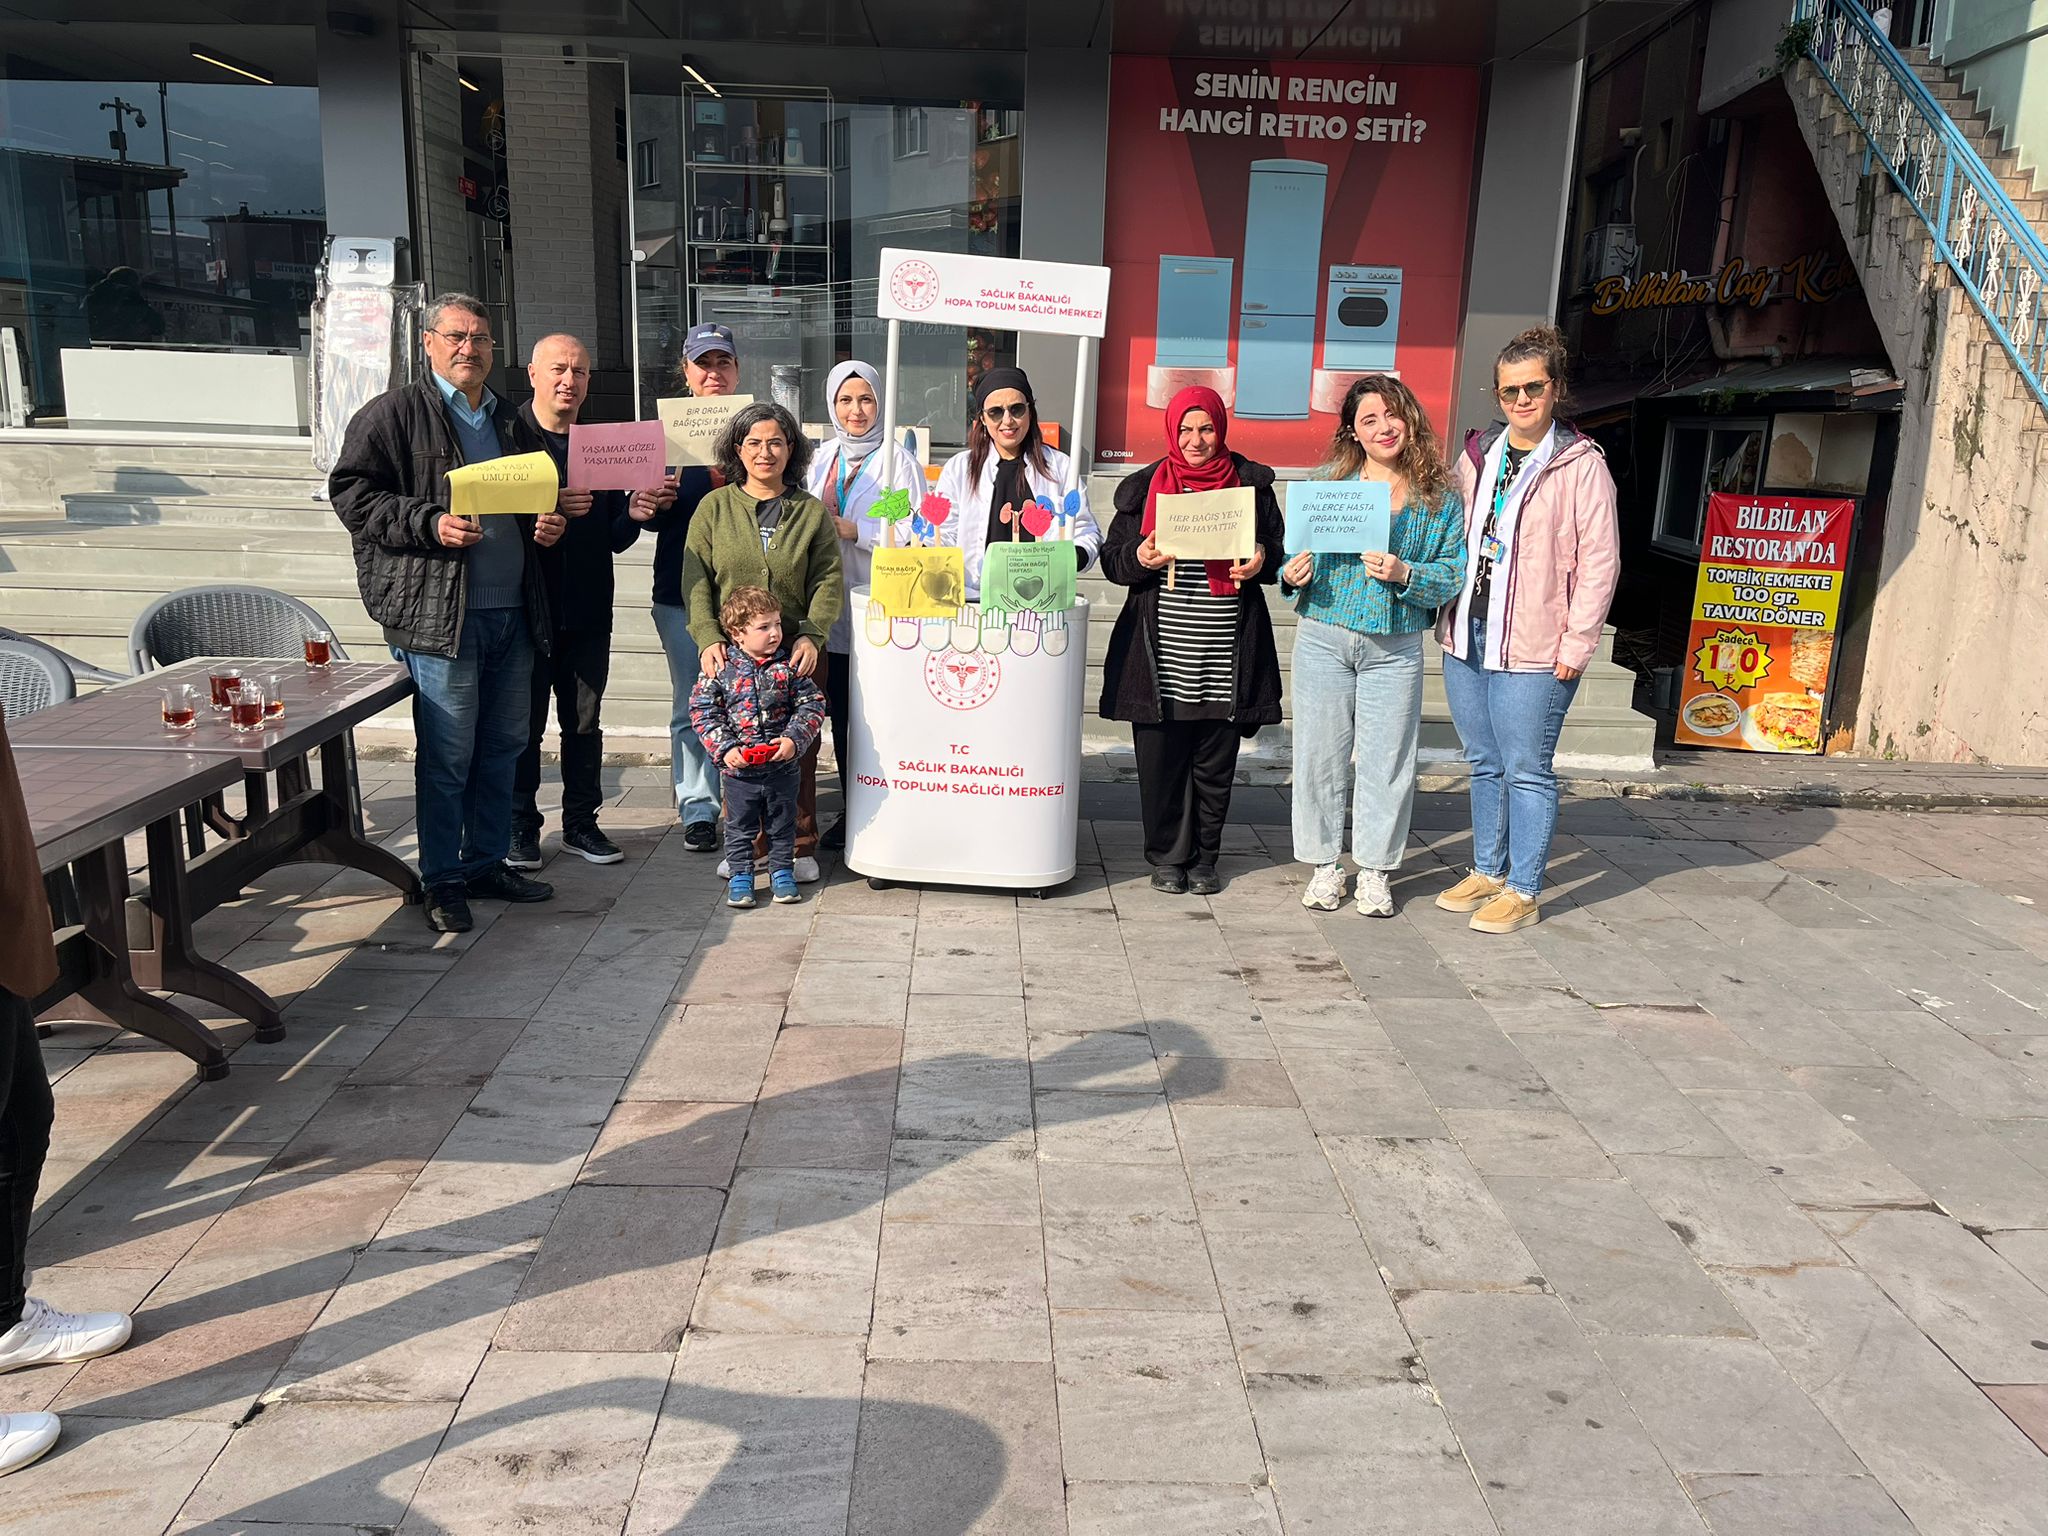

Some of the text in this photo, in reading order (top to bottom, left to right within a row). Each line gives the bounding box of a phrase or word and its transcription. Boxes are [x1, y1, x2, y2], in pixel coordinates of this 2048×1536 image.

[1194, 68, 1397, 105] SENİN RENGİN
[1159, 105, 1427, 143] HANGİ RETRO SETİ?
[1019, 280, 1034, 290] T.C
[980, 288, 1071, 304] SAĞLIK BAKANLIĞI
[944, 297, 1102, 319] HOPA TOPLUM SAĞLIĞI MERKEZİ
[702, 406, 729, 415] ORGAN
[581, 442, 656, 454] YAŞAMAK GÜZEL
[583, 456, 634, 466] YAŞATMAK
[481, 473, 529, 481] UMUT OL!
[1302, 503, 1374, 511] BİNLERCE HASTA
[1169, 514, 1190, 522] HER
[1221, 509, 1243, 519] YENİ
[1341, 514, 1368, 522] NAKLİ
[1735, 500, 1827, 533] BİLBİLAN
[1174, 522, 1238, 533] BİR HAYATTIR
[1710, 535, 1836, 564] RESTORAN'DA
[1707, 568, 1832, 591] TOMBİK EKMEKTE
[1733, 586, 1799, 606] 100 gr.
[1702, 603, 1825, 626] TAVUK DÖNER
[1718, 633, 1754, 646] Sadece
[950, 744, 970, 755] T.C
[899, 760, 1024, 777] SAĞLIK BAKANLIĞI
[856, 773, 1064, 797] HOPA TOPLUM SAĞLIĞI MERKEZİ
